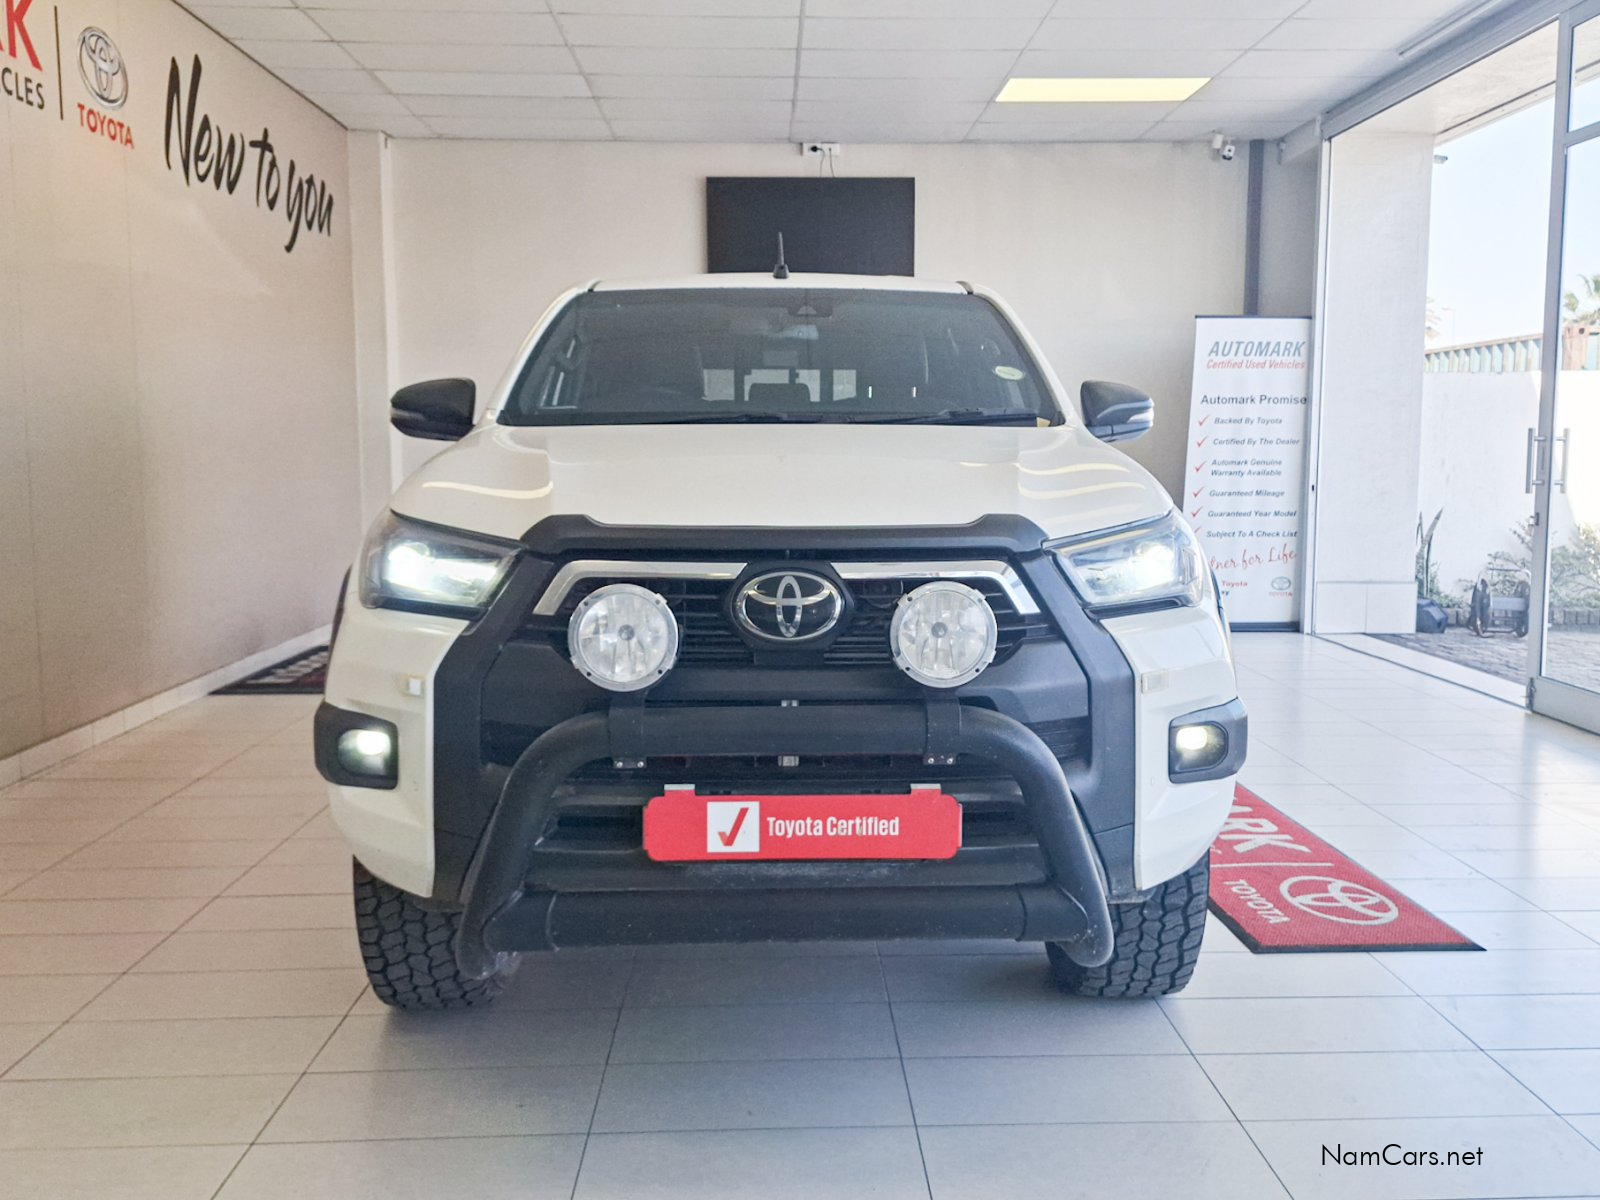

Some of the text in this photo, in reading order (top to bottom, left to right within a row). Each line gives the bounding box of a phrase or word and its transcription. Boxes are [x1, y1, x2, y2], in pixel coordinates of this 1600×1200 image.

[0, 0, 43, 72] K
[77, 102, 135, 149] TOYOTA
[164, 54, 334, 253] New to you
[1208, 341, 1306, 357] AUTOMARK
[1206, 359, 1305, 369] Certified Used Vehicles
[1201, 394, 1307, 405] Automark Promise
[1245, 417, 1254, 425] By
[1257, 417, 1282, 425] Toyota
[1213, 438, 1245, 446] Certified
[1247, 438, 1256, 446] By
[1211, 470, 1245, 478] Warranty
[1255, 490, 1285, 498] Mileage
[1208, 510, 1297, 518] Guaranteed Year Model
[1206, 530, 1235, 539] Subject
[1256, 530, 1280, 538] Check
[1282, 530, 1298, 538] List
[1242, 549, 1263, 570] for
[1268, 543, 1296, 564] Life
[766, 815, 900, 838] Toyota Certified
[1223, 879, 1291, 924] TOYOTA
